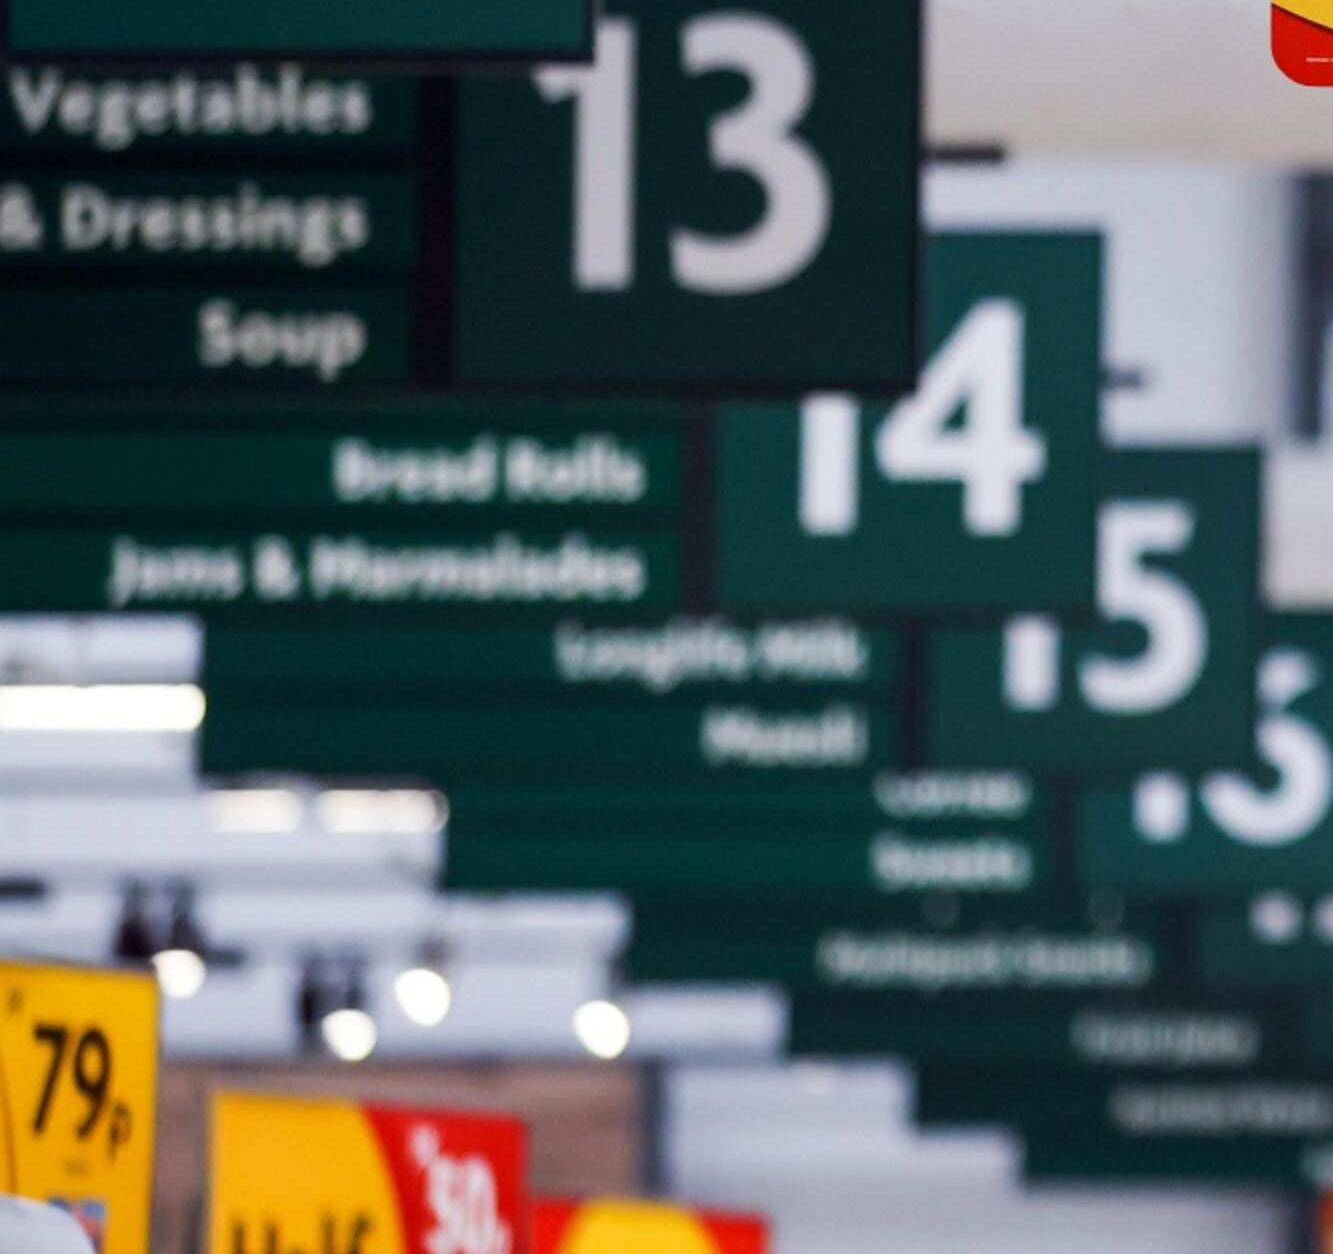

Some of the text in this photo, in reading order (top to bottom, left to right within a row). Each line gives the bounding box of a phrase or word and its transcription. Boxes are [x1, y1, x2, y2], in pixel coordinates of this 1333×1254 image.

[8, 61, 373, 150] Vegetables
[532, 7, 834, 297] 13
[0, 179, 370, 269] & Dressings
[198, 298, 368, 384] Soup
[797, 297, 1047, 536] 14
[333, 434, 648, 503] Bread Rolls
[109, 531, 647, 607] Jams & Marmalades
